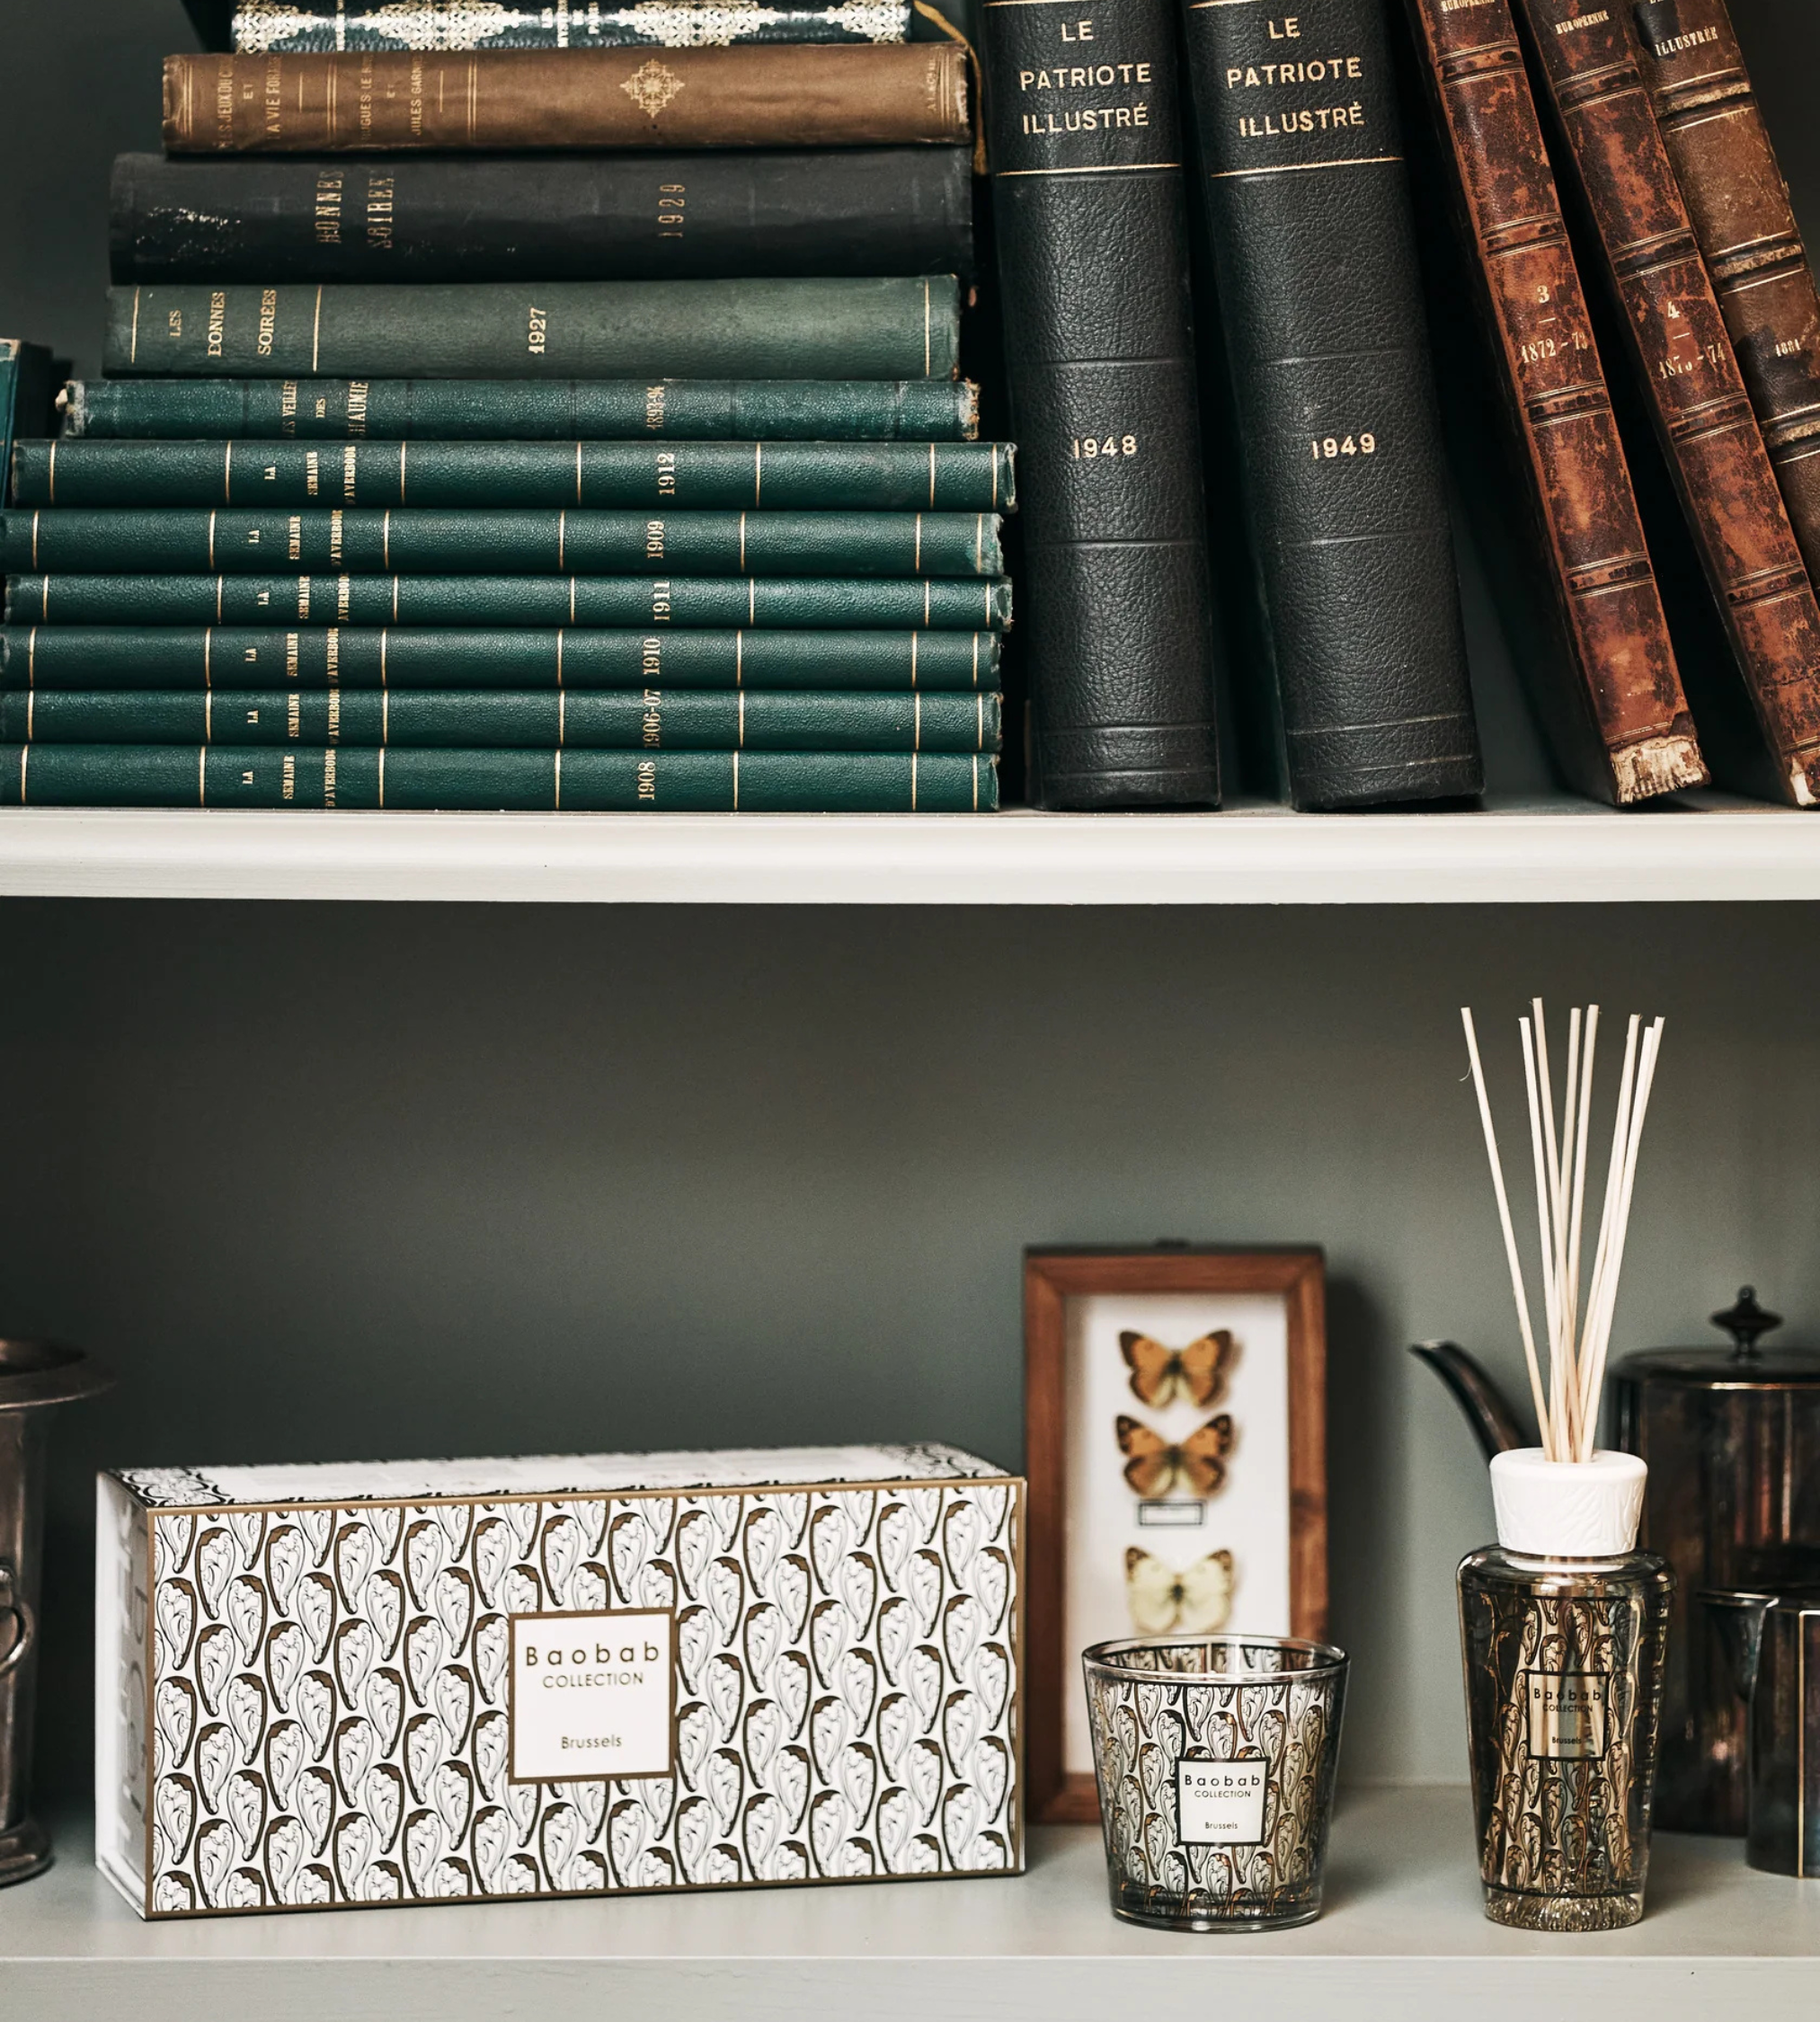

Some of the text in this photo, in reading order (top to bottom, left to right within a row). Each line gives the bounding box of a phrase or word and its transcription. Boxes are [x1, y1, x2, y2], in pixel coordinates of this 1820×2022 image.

[1061, 21, 1094, 41] LE
[1268, 17, 1301, 40] LE
[1020, 63, 1151, 91] PATRIOTE
[1227, 57, 1363, 89] PATRIOTE
[265, 99, 280, 120] VIE
[411, 99, 422, 136] JULES
[1023, 102, 1149, 135] ILLUSTRÉ
[1238, 101, 1365, 137] ILLUSTRÉ
[658, 184, 685, 237] 1929
[1537, 285, 1550, 304] 3
[1667, 300, 1681, 319] 4
[169, 310, 182, 337] LES
[528, 307, 546, 353] 1927
[315, 398, 325, 418] DES
[1073, 435, 1137, 458] 1948
[1312, 433, 1375, 459] 1949
[264, 466, 276, 480] LA
[306, 451, 318, 495] SEMAINE
[657, 452, 675, 495] 1912
[248, 529, 260, 544] LA
[289, 515, 301, 560] SEMAINE
[646, 520, 664, 559] 1909
[257, 591, 270, 606] LA
[298, 575, 310, 619] SEMAINE
[653, 581, 670, 621] 1911
[244, 648, 257, 661] LA
[286, 633, 298, 677] SEMAINE
[643, 637, 661, 675] 1910
[246, 710, 259, 723] LA
[289, 694, 300, 737] SEMAINE
[643, 688, 661, 748] 1906-07
[242, 771, 253, 785] LA
[283, 755, 295, 799] SEMAINE
[324, 749, 336, 807] D'AVERBODE
[637, 761, 656, 800] 1908
[526, 1642, 659, 1666] Baobab
[543, 1672, 644, 1689] COLLECTION
[1533, 1688, 1602, 1701] Baobab
[1543, 1704, 1593, 1713] COLLECTION
[561, 1734, 622, 1750] Brussels
[1551, 1736, 1582, 1744] Brussels
[1185, 1775, 1260, 1787] Baobab
[1194, 1790, 1251, 1798] COLLECTION
[1205, 1822, 1238, 1830] Brussels
